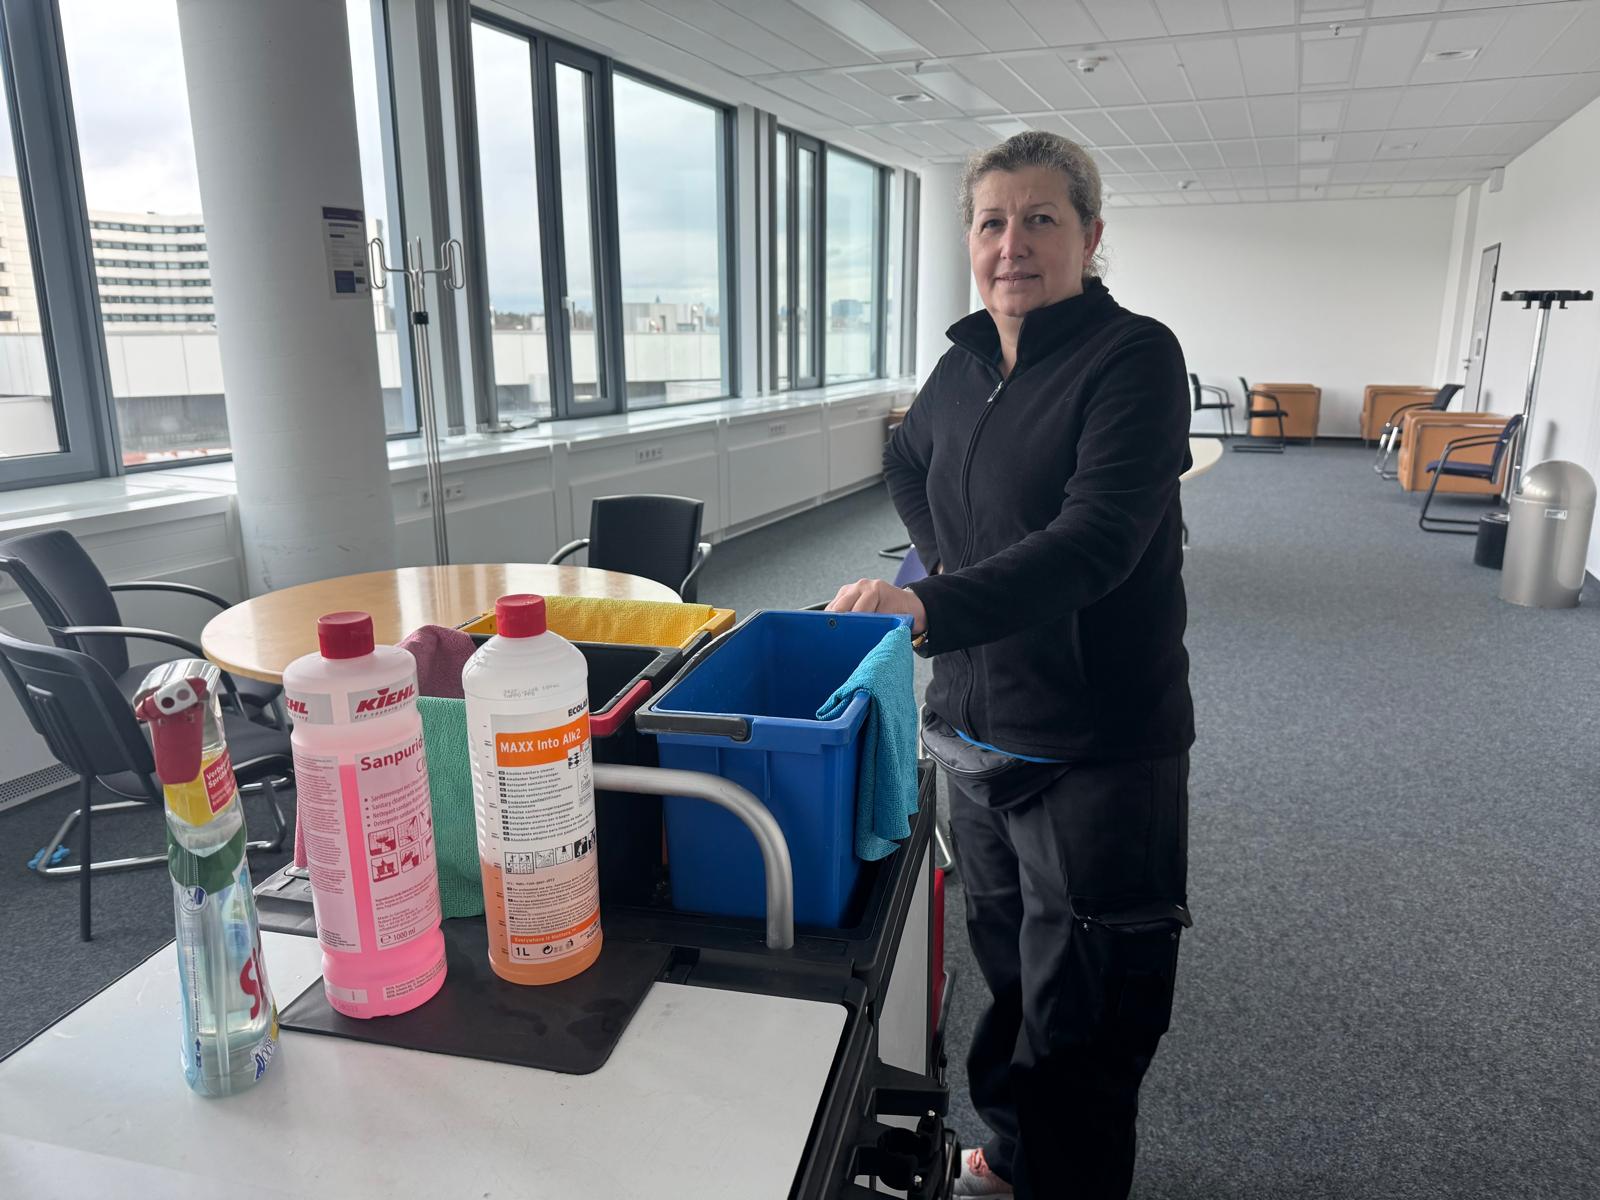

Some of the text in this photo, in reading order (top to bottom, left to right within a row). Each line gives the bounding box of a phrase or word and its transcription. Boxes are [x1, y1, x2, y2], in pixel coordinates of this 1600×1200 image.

[500, 728, 581, 753] MAXX Into Alk2
[393, 927, 416, 941] 1000 ml
